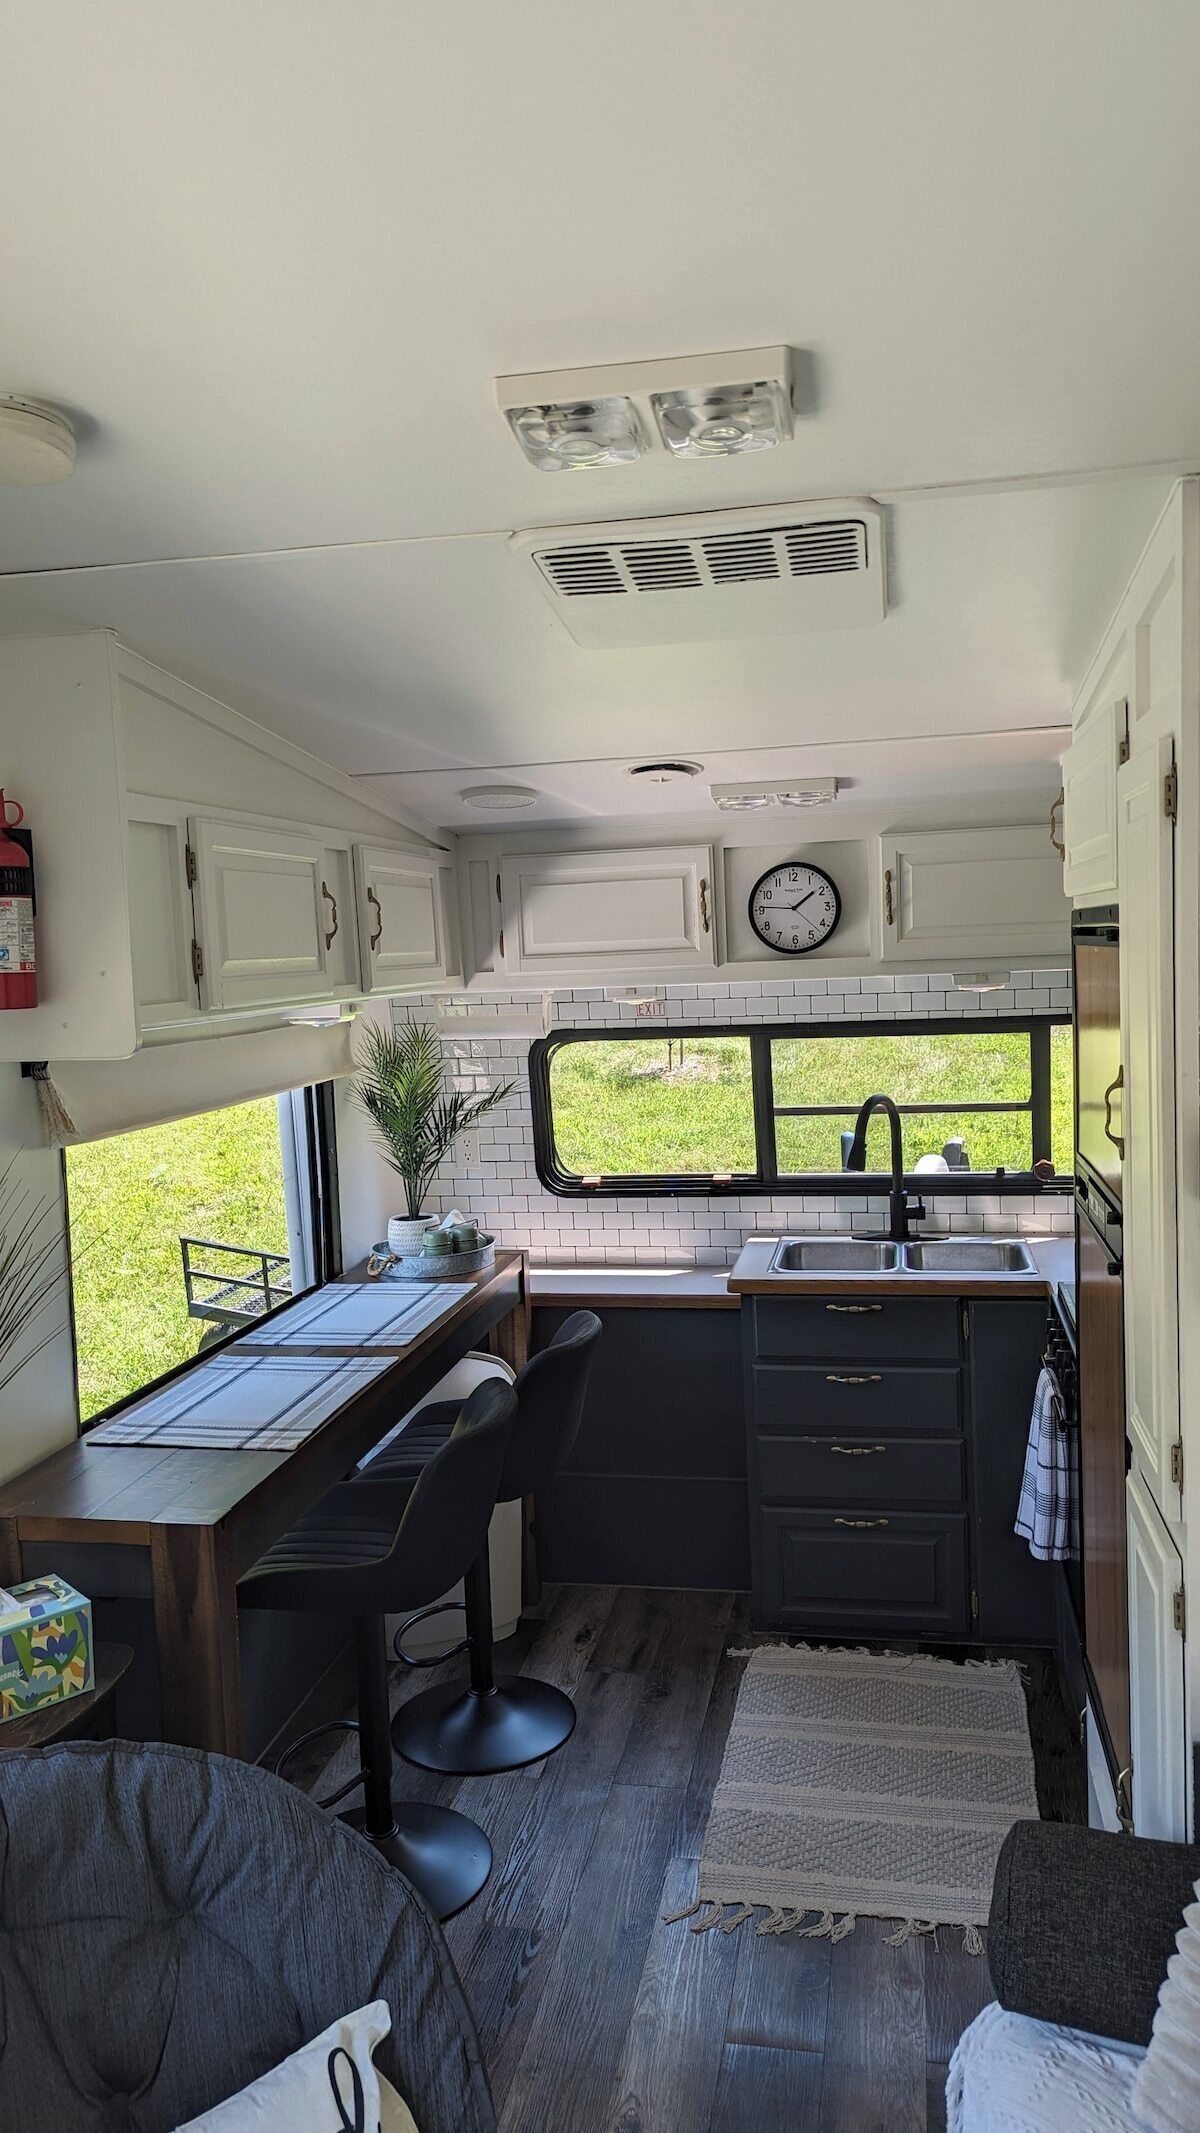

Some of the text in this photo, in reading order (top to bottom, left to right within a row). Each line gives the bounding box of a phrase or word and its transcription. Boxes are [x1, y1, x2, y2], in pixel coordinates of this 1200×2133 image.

[789, 872, 798, 882] 12
[775, 878, 781, 887] 11
[763, 890, 772, 900] 10
[819, 886, 825, 896] 2
[759, 906, 765, 915] 9
[824, 902, 831, 911] 3
[764, 921, 770, 930] 8
[820, 918, 826, 927] 4
[777, 932, 782, 941] 7
[792, 935, 799, 944] 6
[808, 930, 815, 940] 5
[638, 1003, 662, 1016] EXIT
